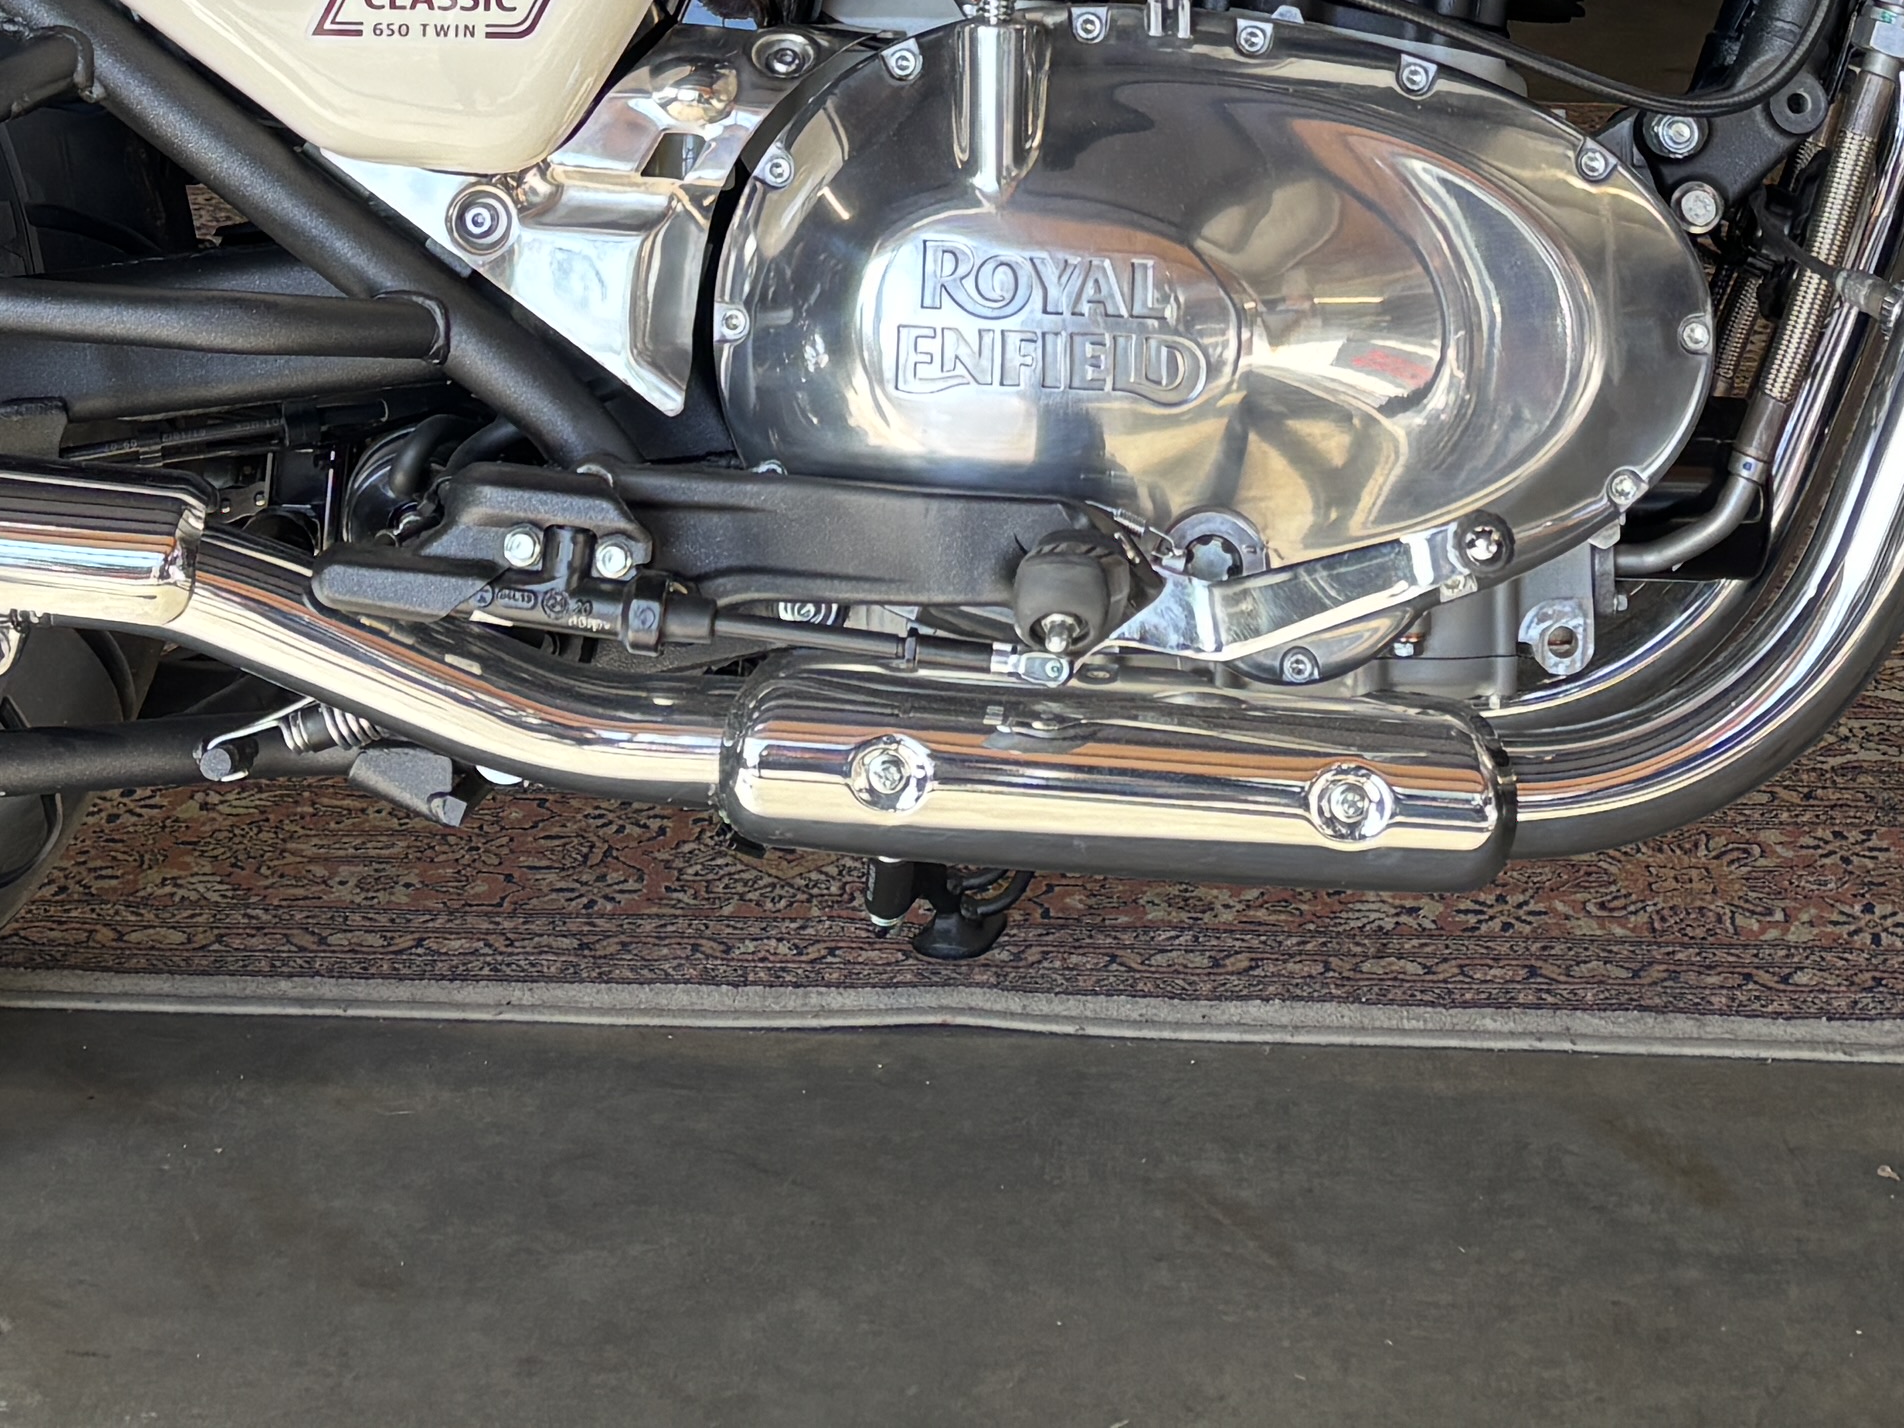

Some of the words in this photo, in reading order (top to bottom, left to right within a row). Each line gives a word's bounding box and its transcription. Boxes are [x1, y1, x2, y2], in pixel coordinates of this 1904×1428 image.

[373, 23, 409, 37] 650
[421, 24, 476, 38] TWIN
[921, 239, 1168, 319] ROYAL
[895, 324, 1208, 408] ENFIELD
